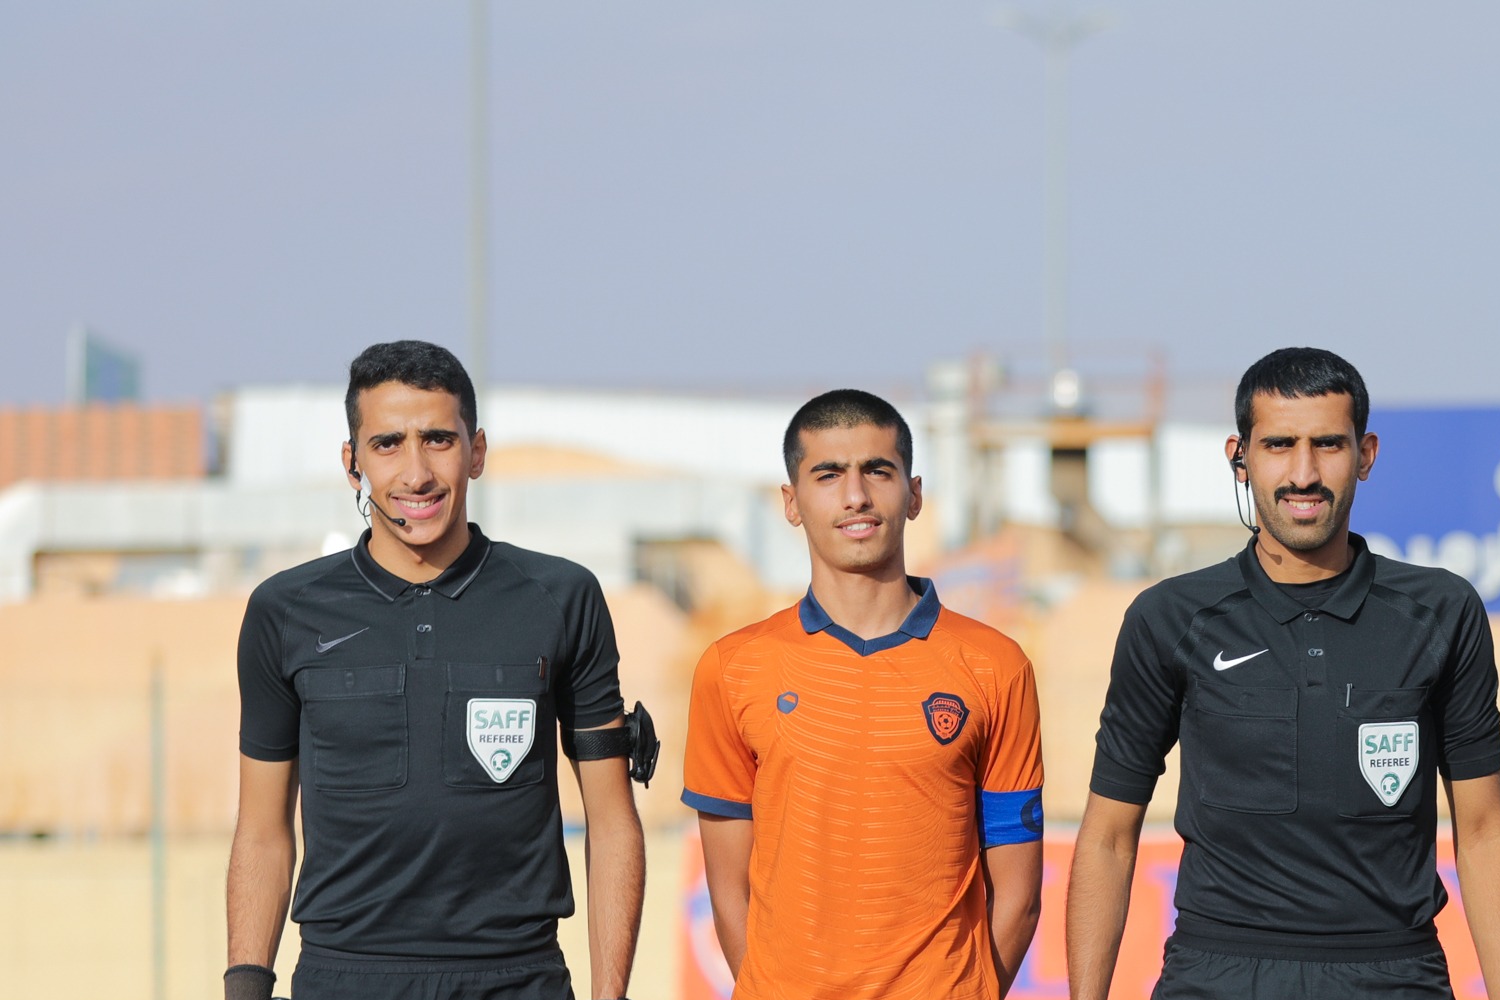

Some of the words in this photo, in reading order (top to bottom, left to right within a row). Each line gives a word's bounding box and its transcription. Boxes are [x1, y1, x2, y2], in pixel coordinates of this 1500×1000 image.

[474, 709, 530, 729] SAFF
[479, 734, 524, 743] REFEREE
[1364, 733, 1414, 754] SAFF
[1370, 757, 1410, 768] REFEREE
